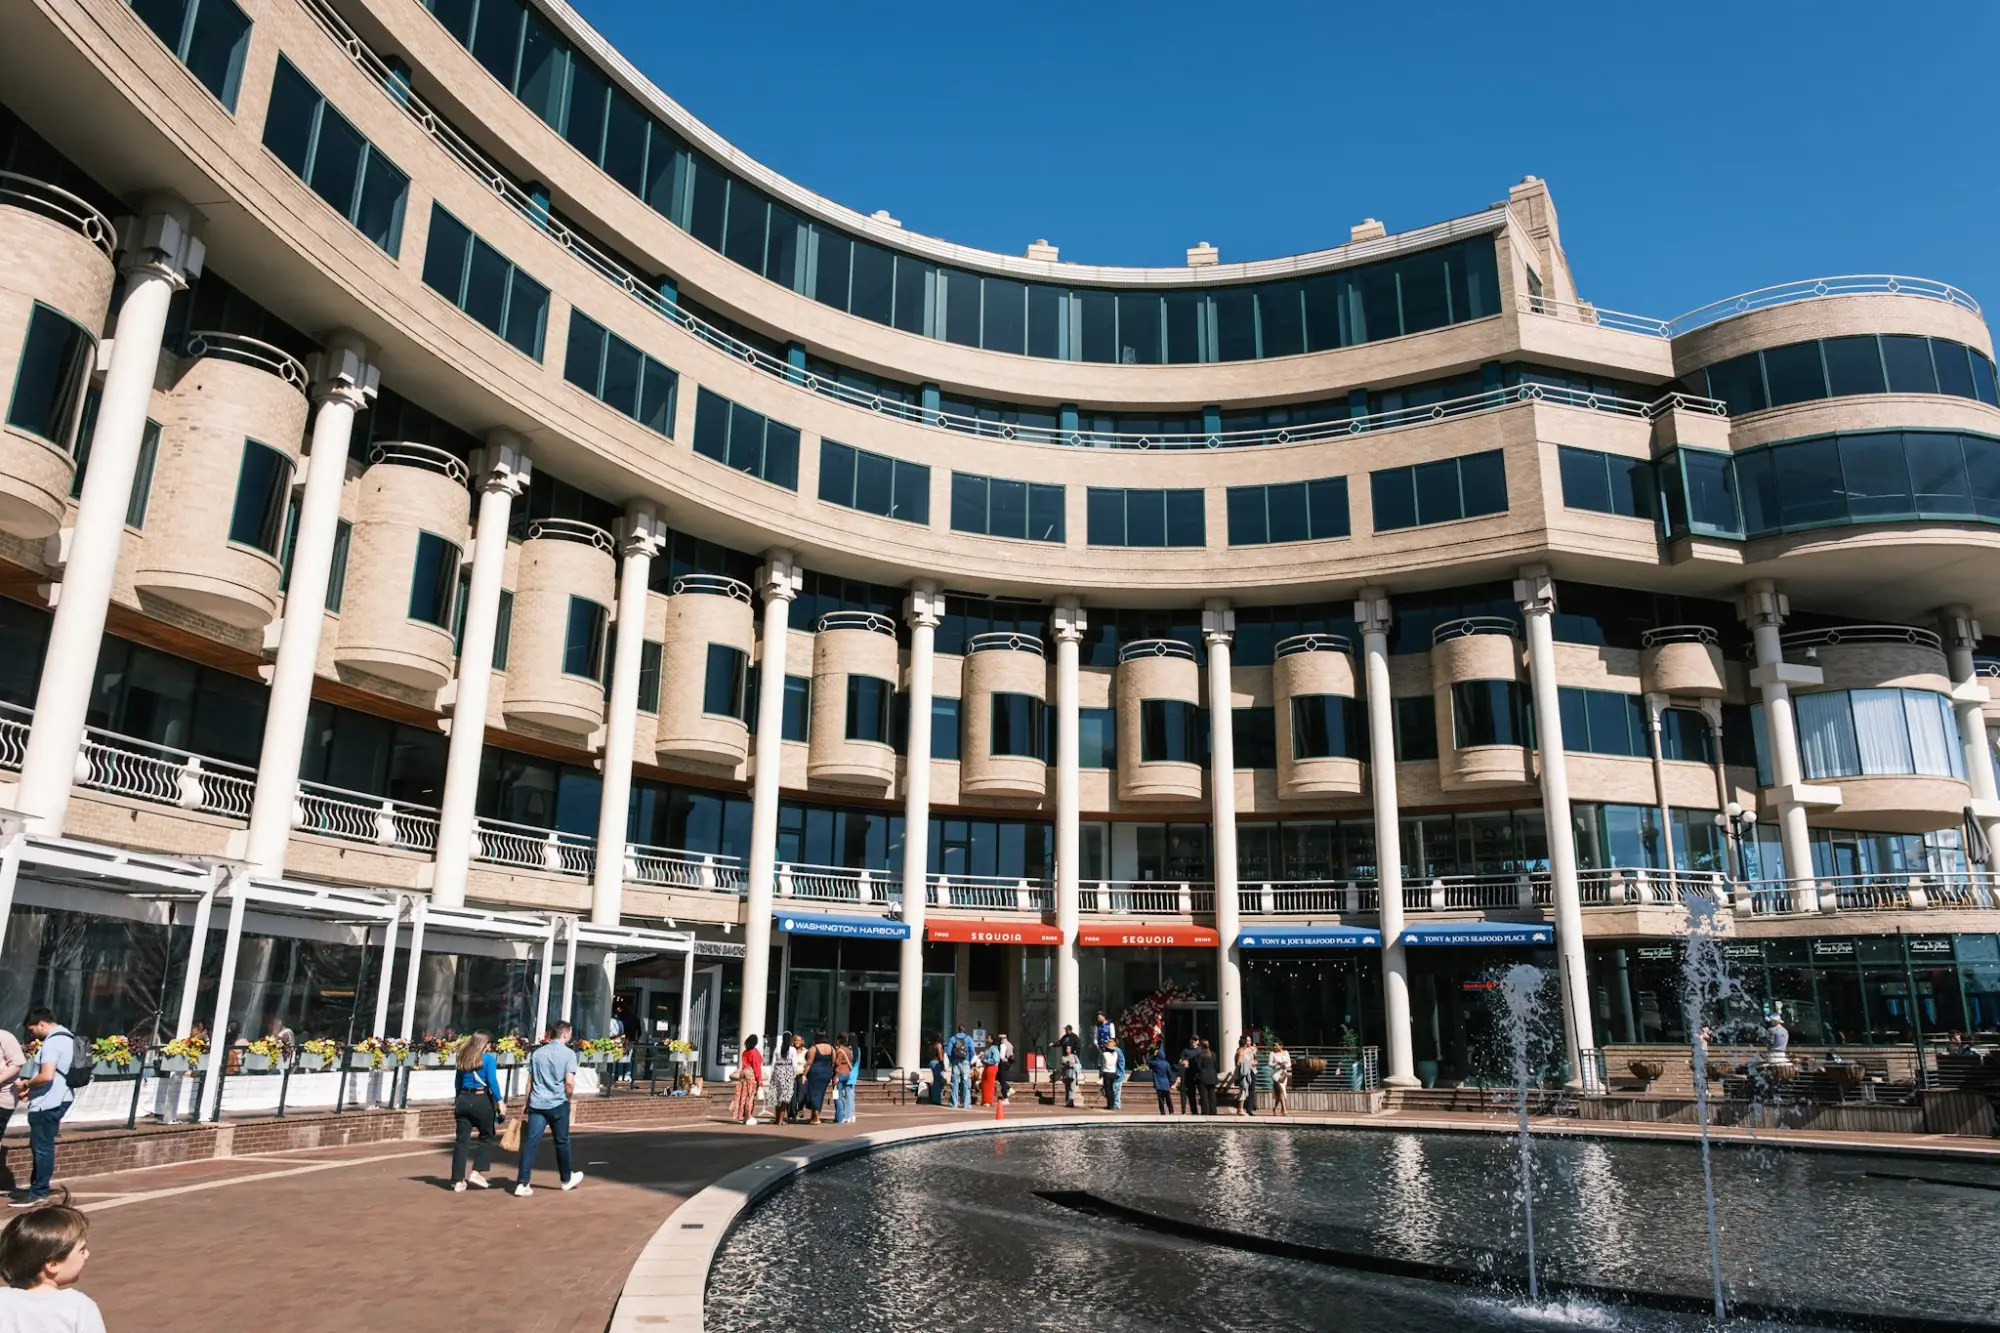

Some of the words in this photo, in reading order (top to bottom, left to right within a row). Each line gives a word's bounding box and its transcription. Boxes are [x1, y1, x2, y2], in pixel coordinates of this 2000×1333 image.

[795, 921, 857, 933] WASHINGTON
[859, 927, 906, 935] HARBOUR
[971, 932, 1021, 942] SEQUOIA
[1122, 936, 1174, 944] SEQUOIA
[1287, 938, 1304, 946] JOE'S
[1305, 937, 1335, 945] SEAFOOD
[1470, 935, 1503, 943] SEAFOOD
